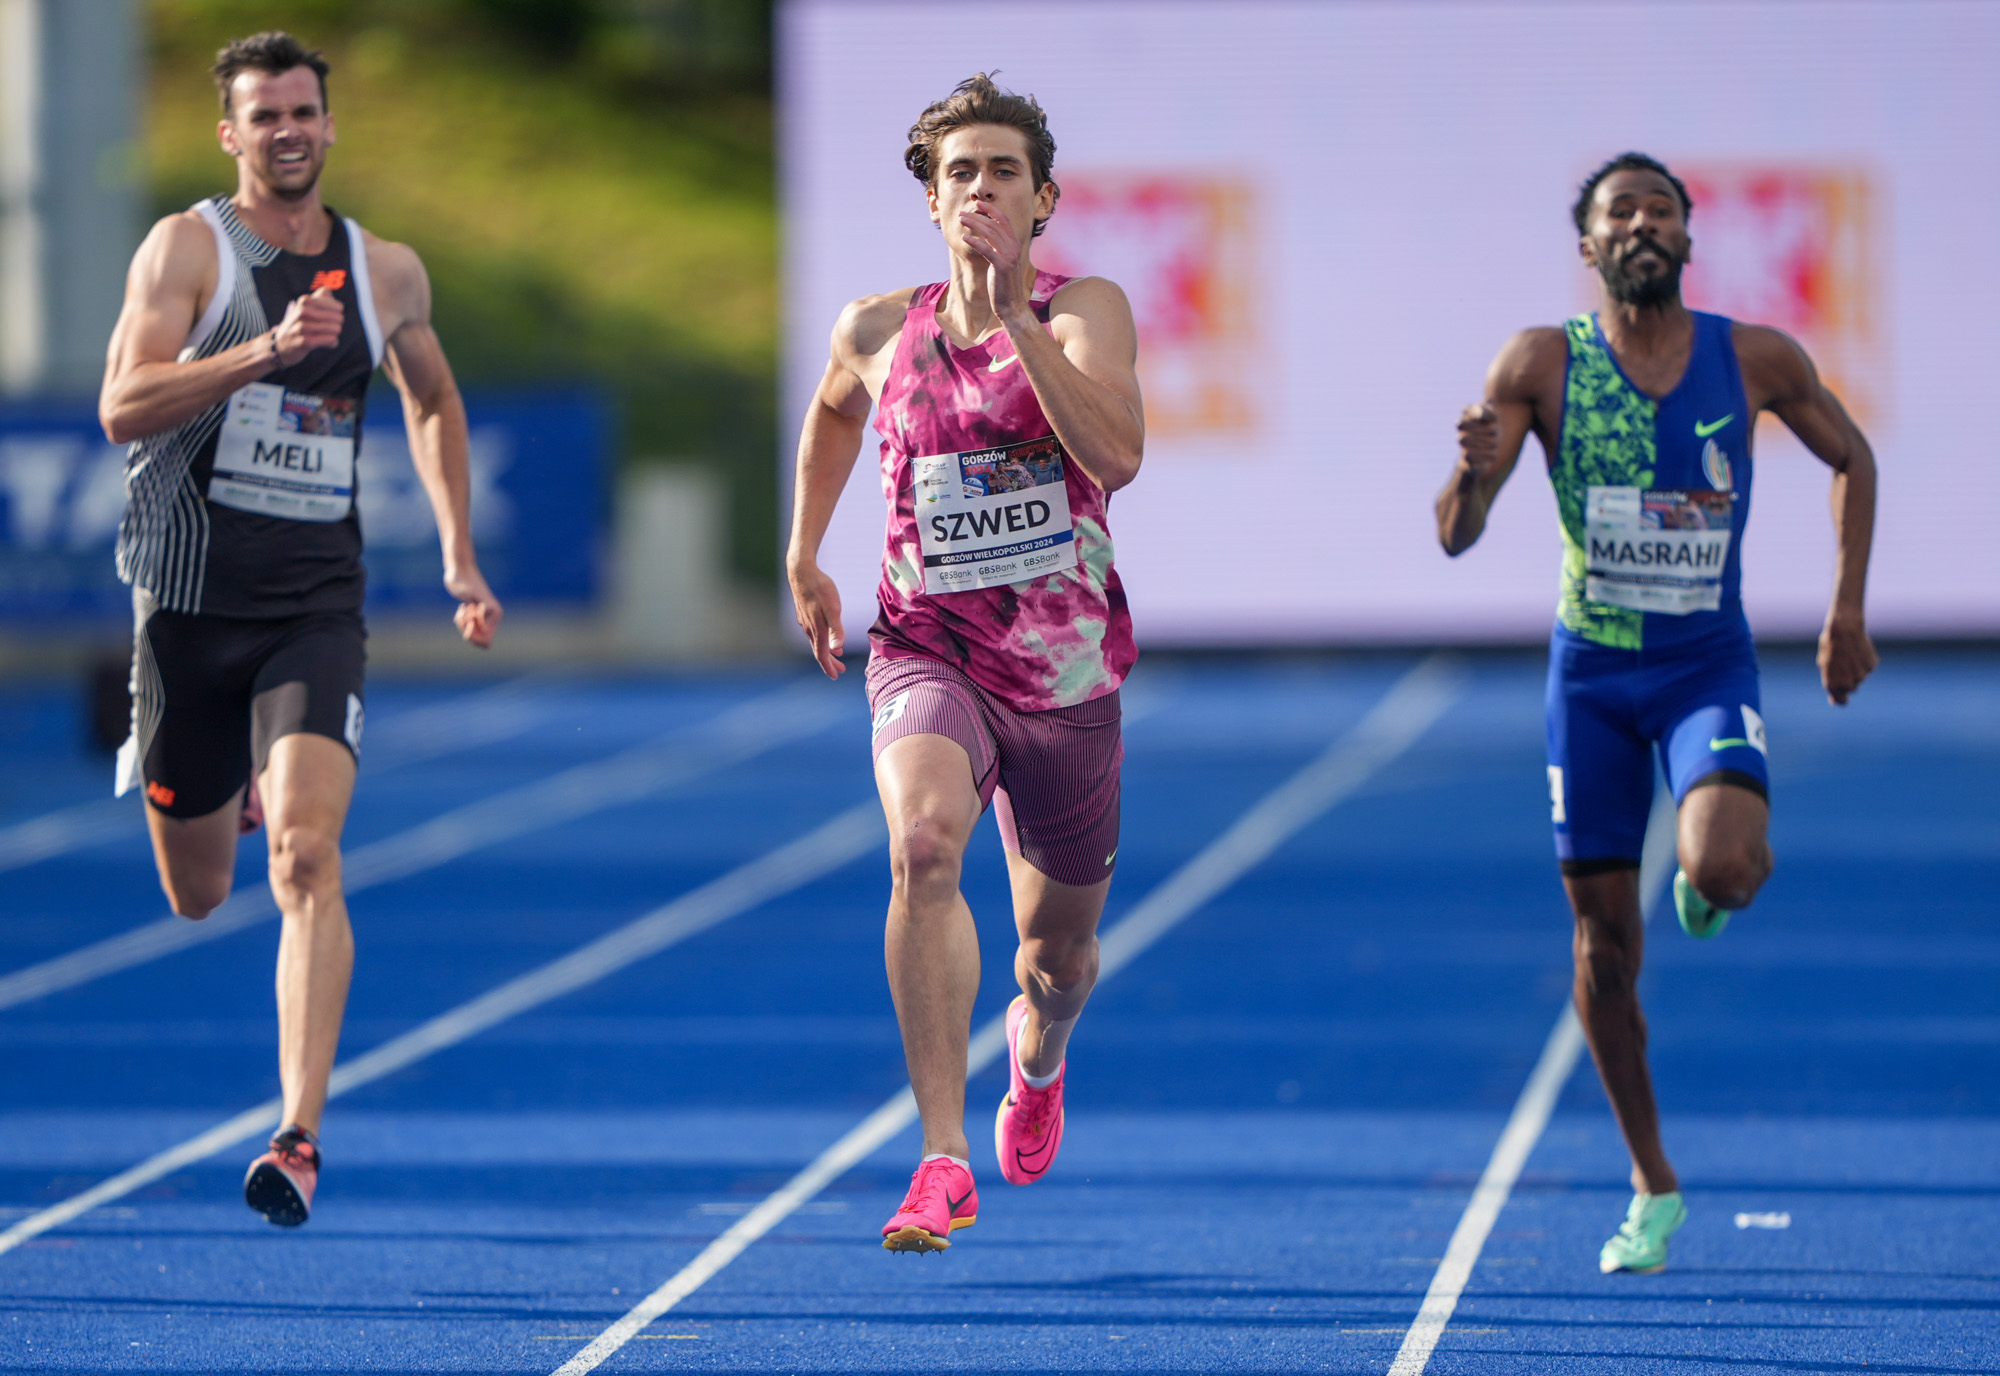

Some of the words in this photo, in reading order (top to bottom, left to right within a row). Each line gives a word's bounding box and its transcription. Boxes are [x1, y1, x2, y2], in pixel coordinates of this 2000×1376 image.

[252, 438, 323, 472] MELI
[962, 450, 1006, 466] GORZÓW
[965, 465, 992, 476] 2024
[931, 500, 1050, 542] SZWED
[941, 552, 973, 564] GORZÓW
[974, 543, 1033, 560] WIELKOPOLSKI
[1034, 538, 1054, 549] 2024
[1023, 551, 1060, 567] GBSBank
[1591, 536, 1720, 567] MASRAHI
[939, 569, 972, 580] GBSBank
[979, 562, 1017, 575] GBSBank
